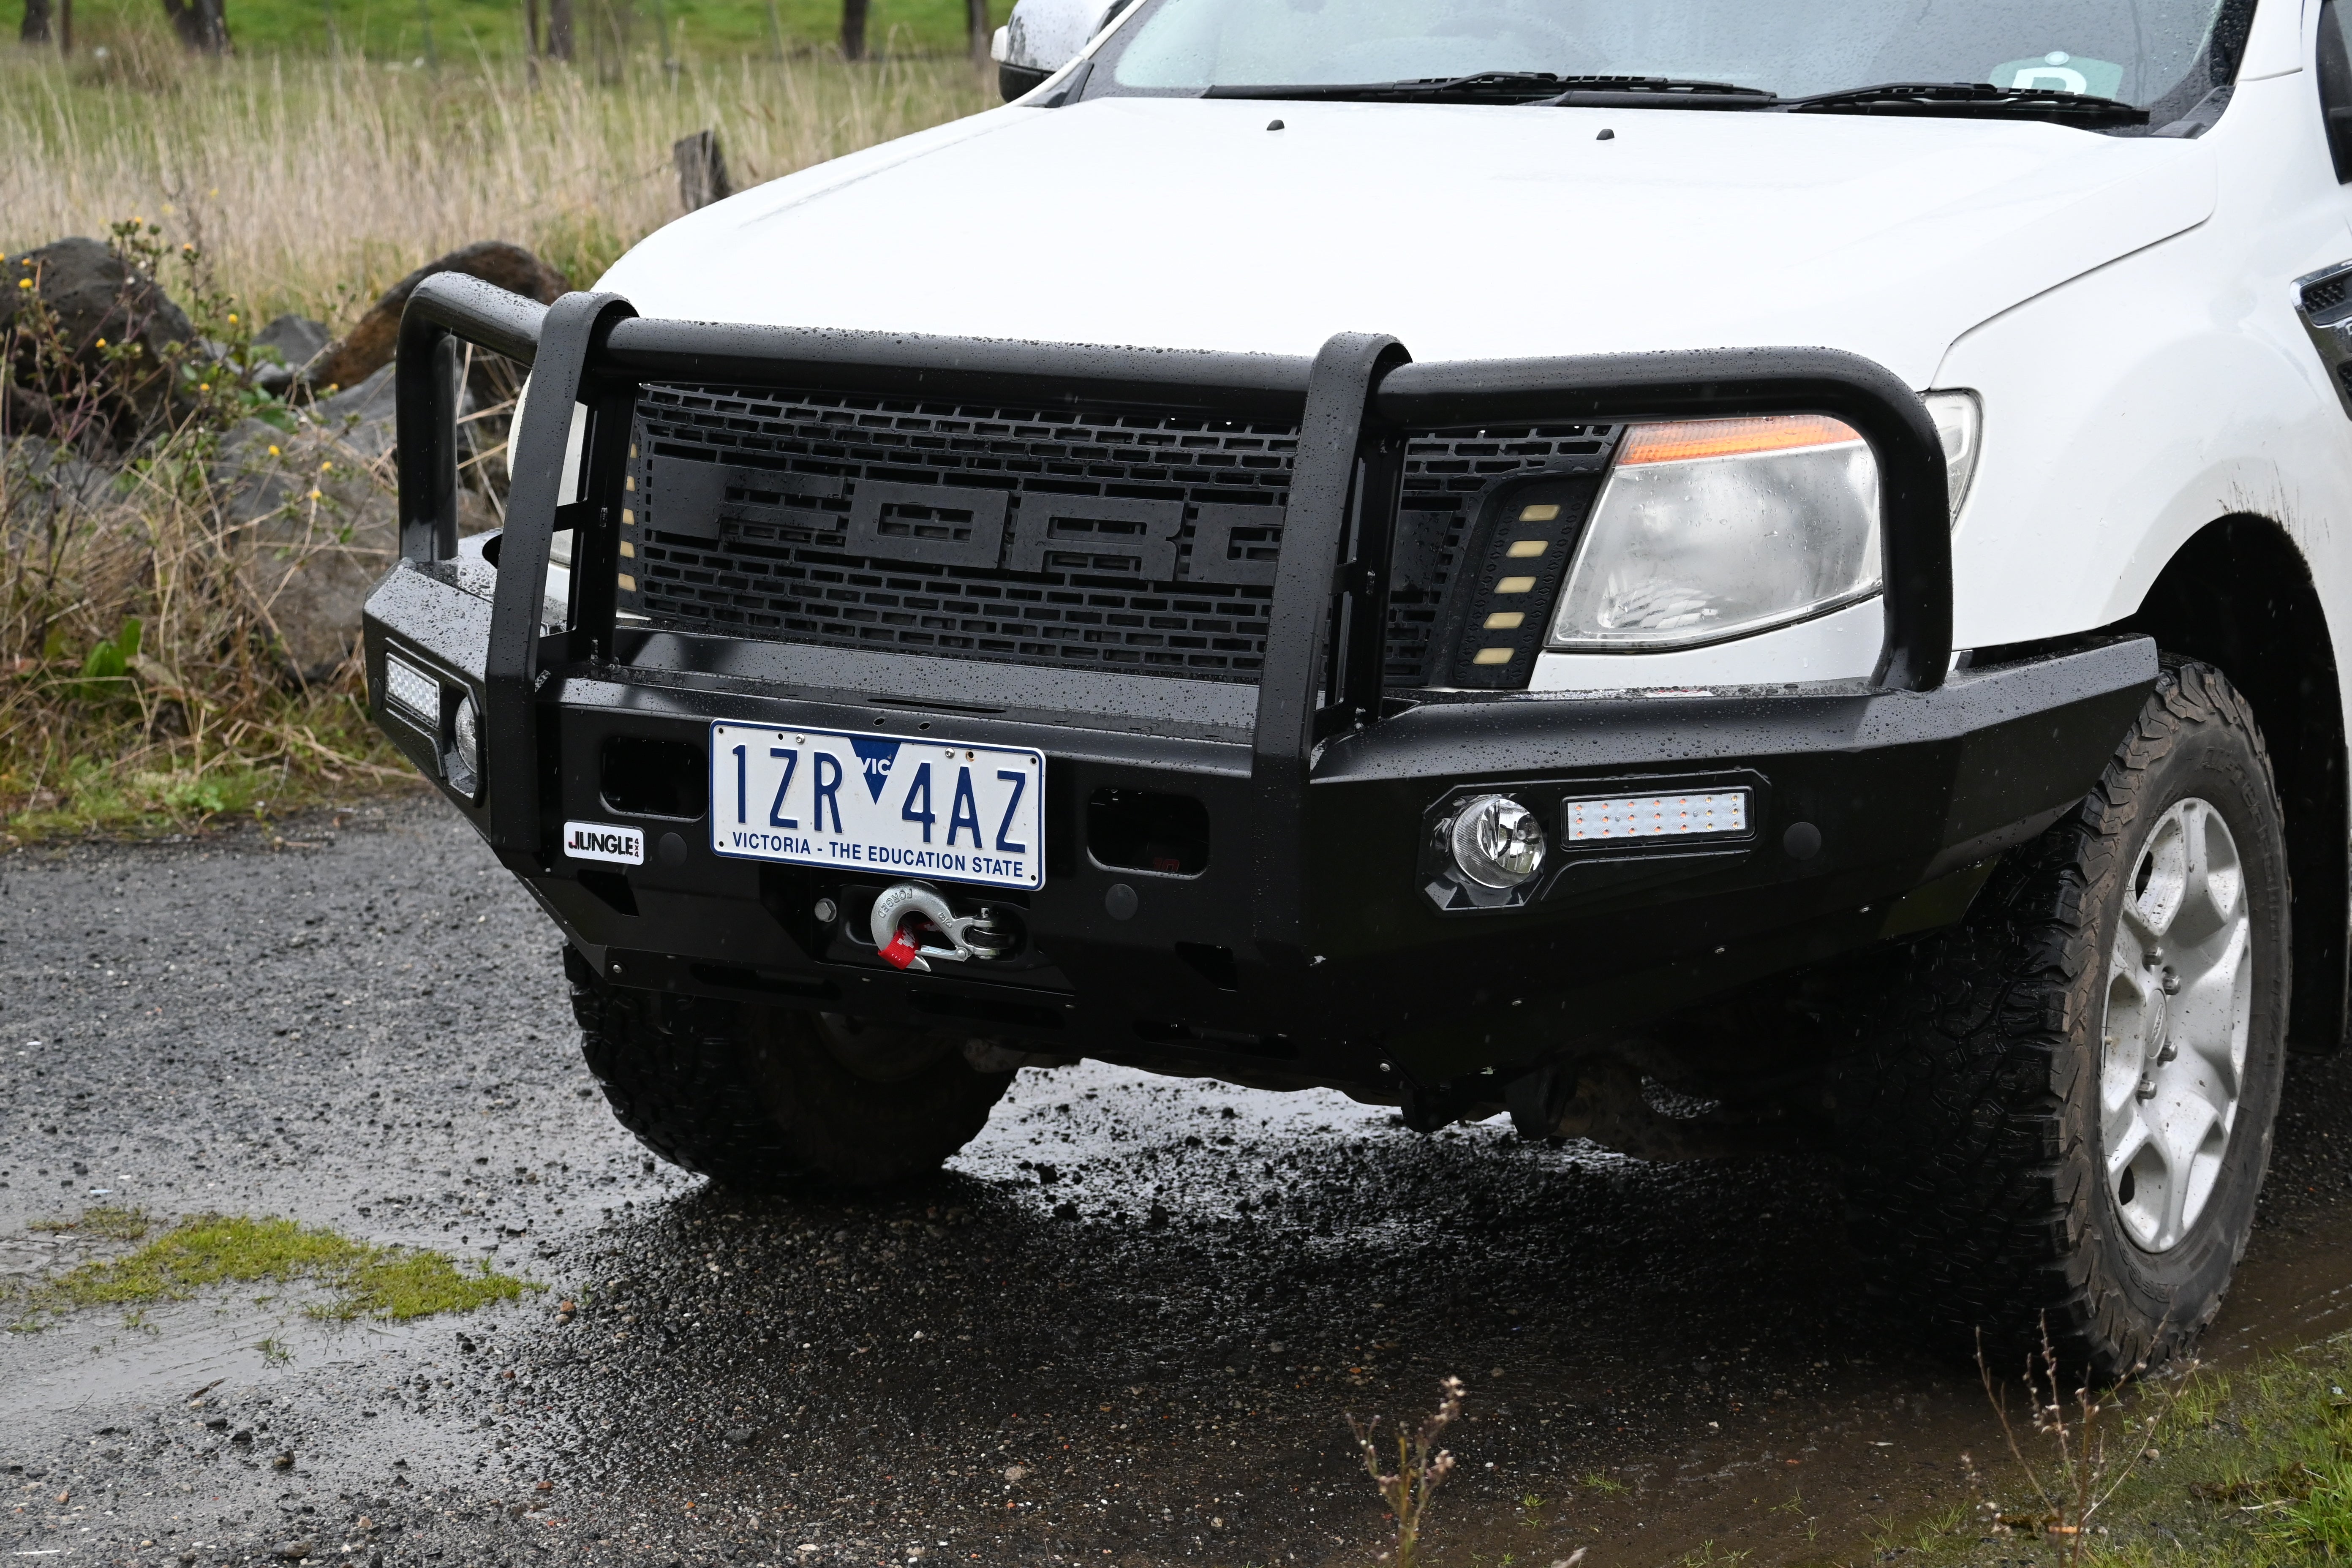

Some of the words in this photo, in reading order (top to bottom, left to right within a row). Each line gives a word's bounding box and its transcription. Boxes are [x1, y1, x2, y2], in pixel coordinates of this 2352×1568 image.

[860, 757, 891, 776] VIC
[732, 744, 843, 834] 1ZR
[901, 762, 1026, 853] 4AZ
[568, 831, 633, 856] JUNGLE
[732, 831, 811, 855] VICTORIA
[829, 841, 861, 860] THE
[869, 846, 966, 871] EDUCATION
[972, 857, 1024, 878] STATE
[878, 888, 913, 918] FORGED
